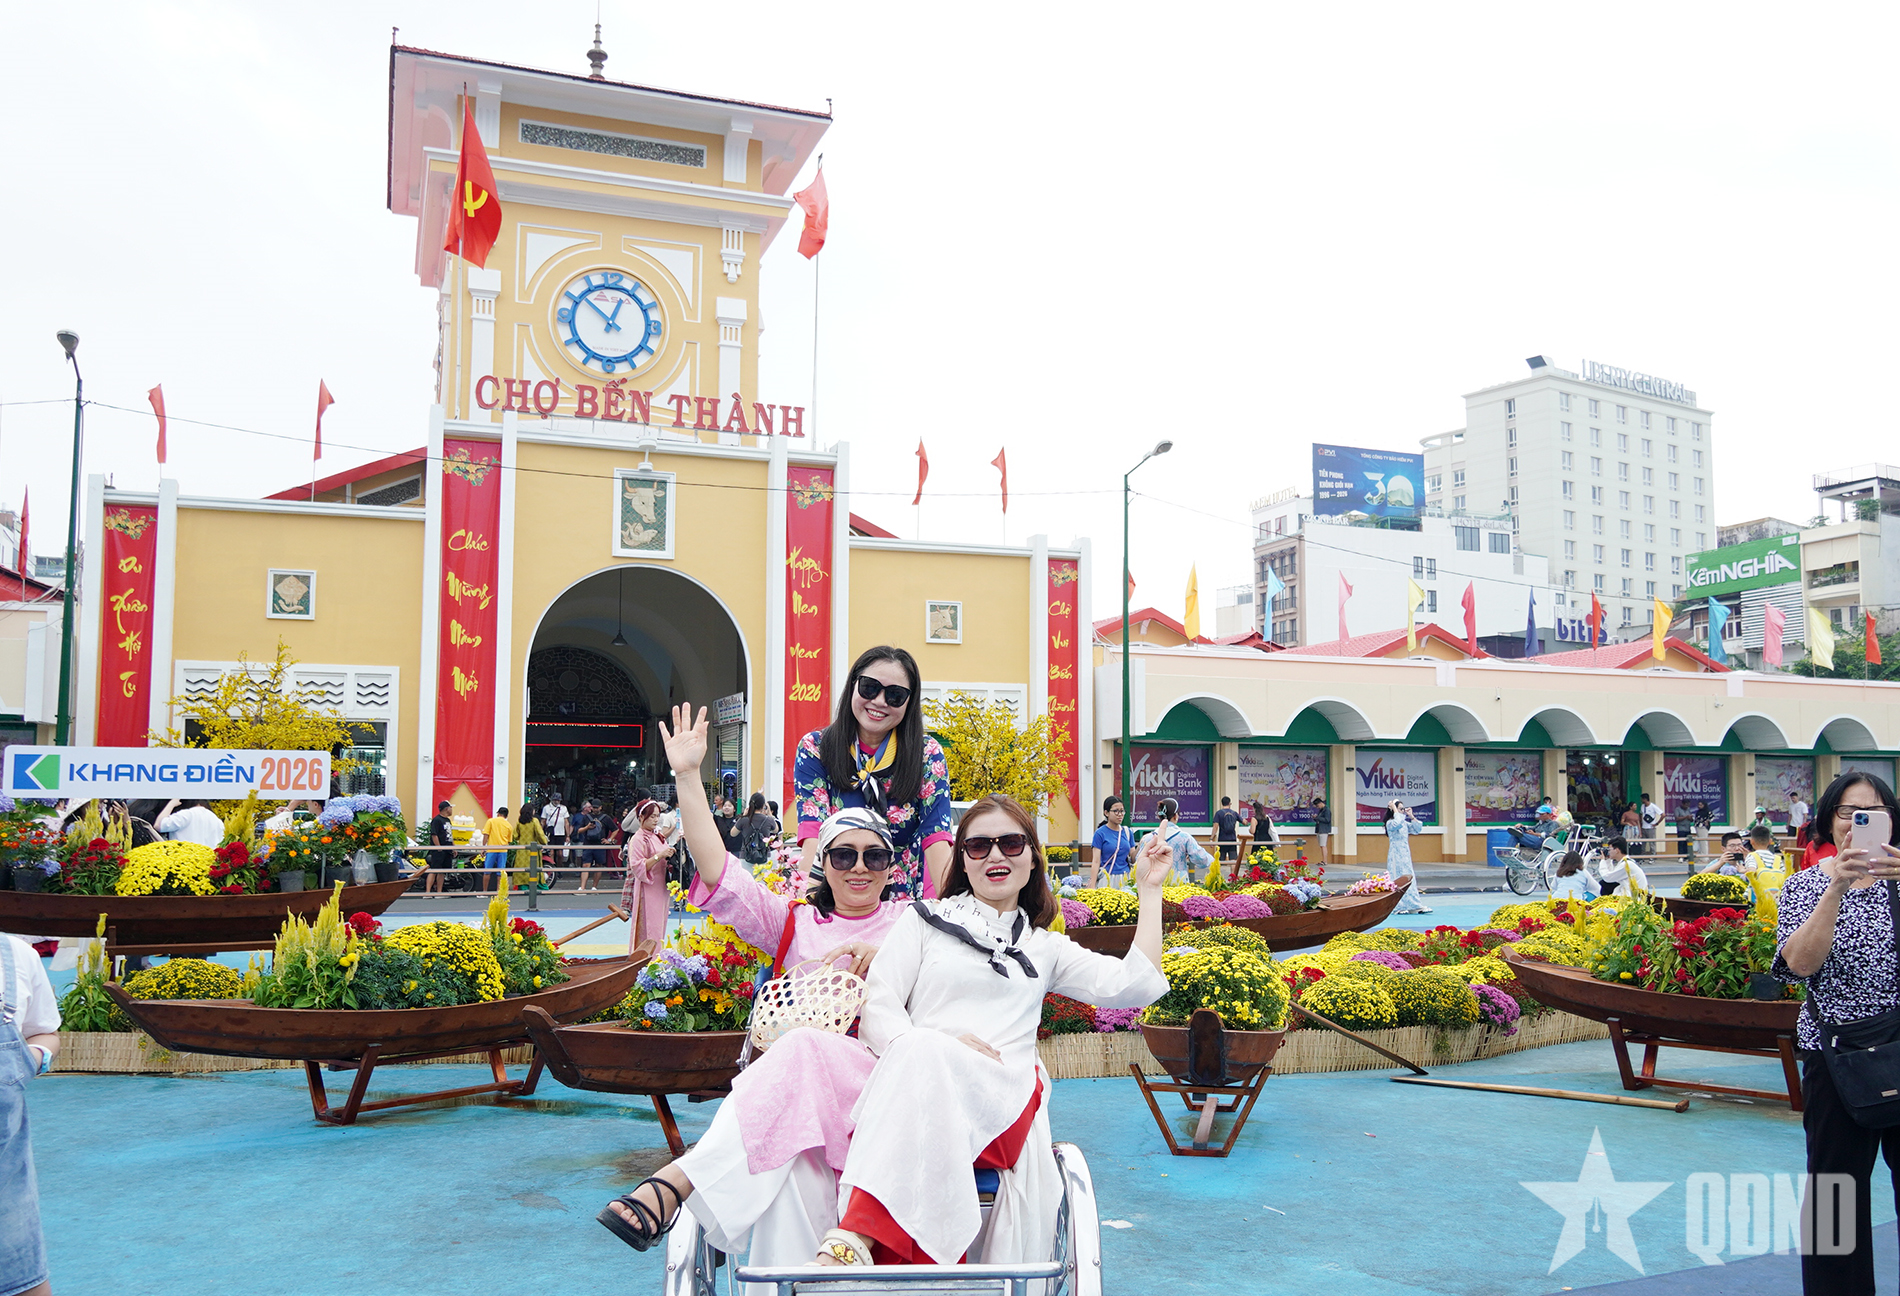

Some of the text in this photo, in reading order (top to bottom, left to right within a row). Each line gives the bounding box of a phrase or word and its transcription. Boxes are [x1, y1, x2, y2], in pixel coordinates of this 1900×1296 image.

[601, 272, 624, 288] 12
[557, 307, 572, 323] 9
[648, 320, 662, 336] 3
[601, 357, 616, 373] 6
[1582, 359, 1689, 404] LIBERTY CENTRAL
[475, 374, 806, 437] CHỢ BẾN THÀNH
[1363, 471, 1414, 509] 30
[448, 529, 490, 551] Chúc
[785, 545, 829, 588] Happy
[446, 571, 494, 610] Mừng
[1048, 600, 1072, 618] Chợ
[1052, 630, 1069, 649] Vui
[789, 643, 822, 684] Year
[1048, 664, 1073, 680] Bến
[789, 683, 822, 701] 2026
[69, 754, 323, 790] KHANG ĐIỀN 2026
[1356, 757, 1404, 789] Vikki
[1664, 763, 1700, 792] Vikki
[1177, 778, 1202, 787] Bank
[1407, 781, 1429, 789] Bank
[1702, 784, 1721, 792] Bank
